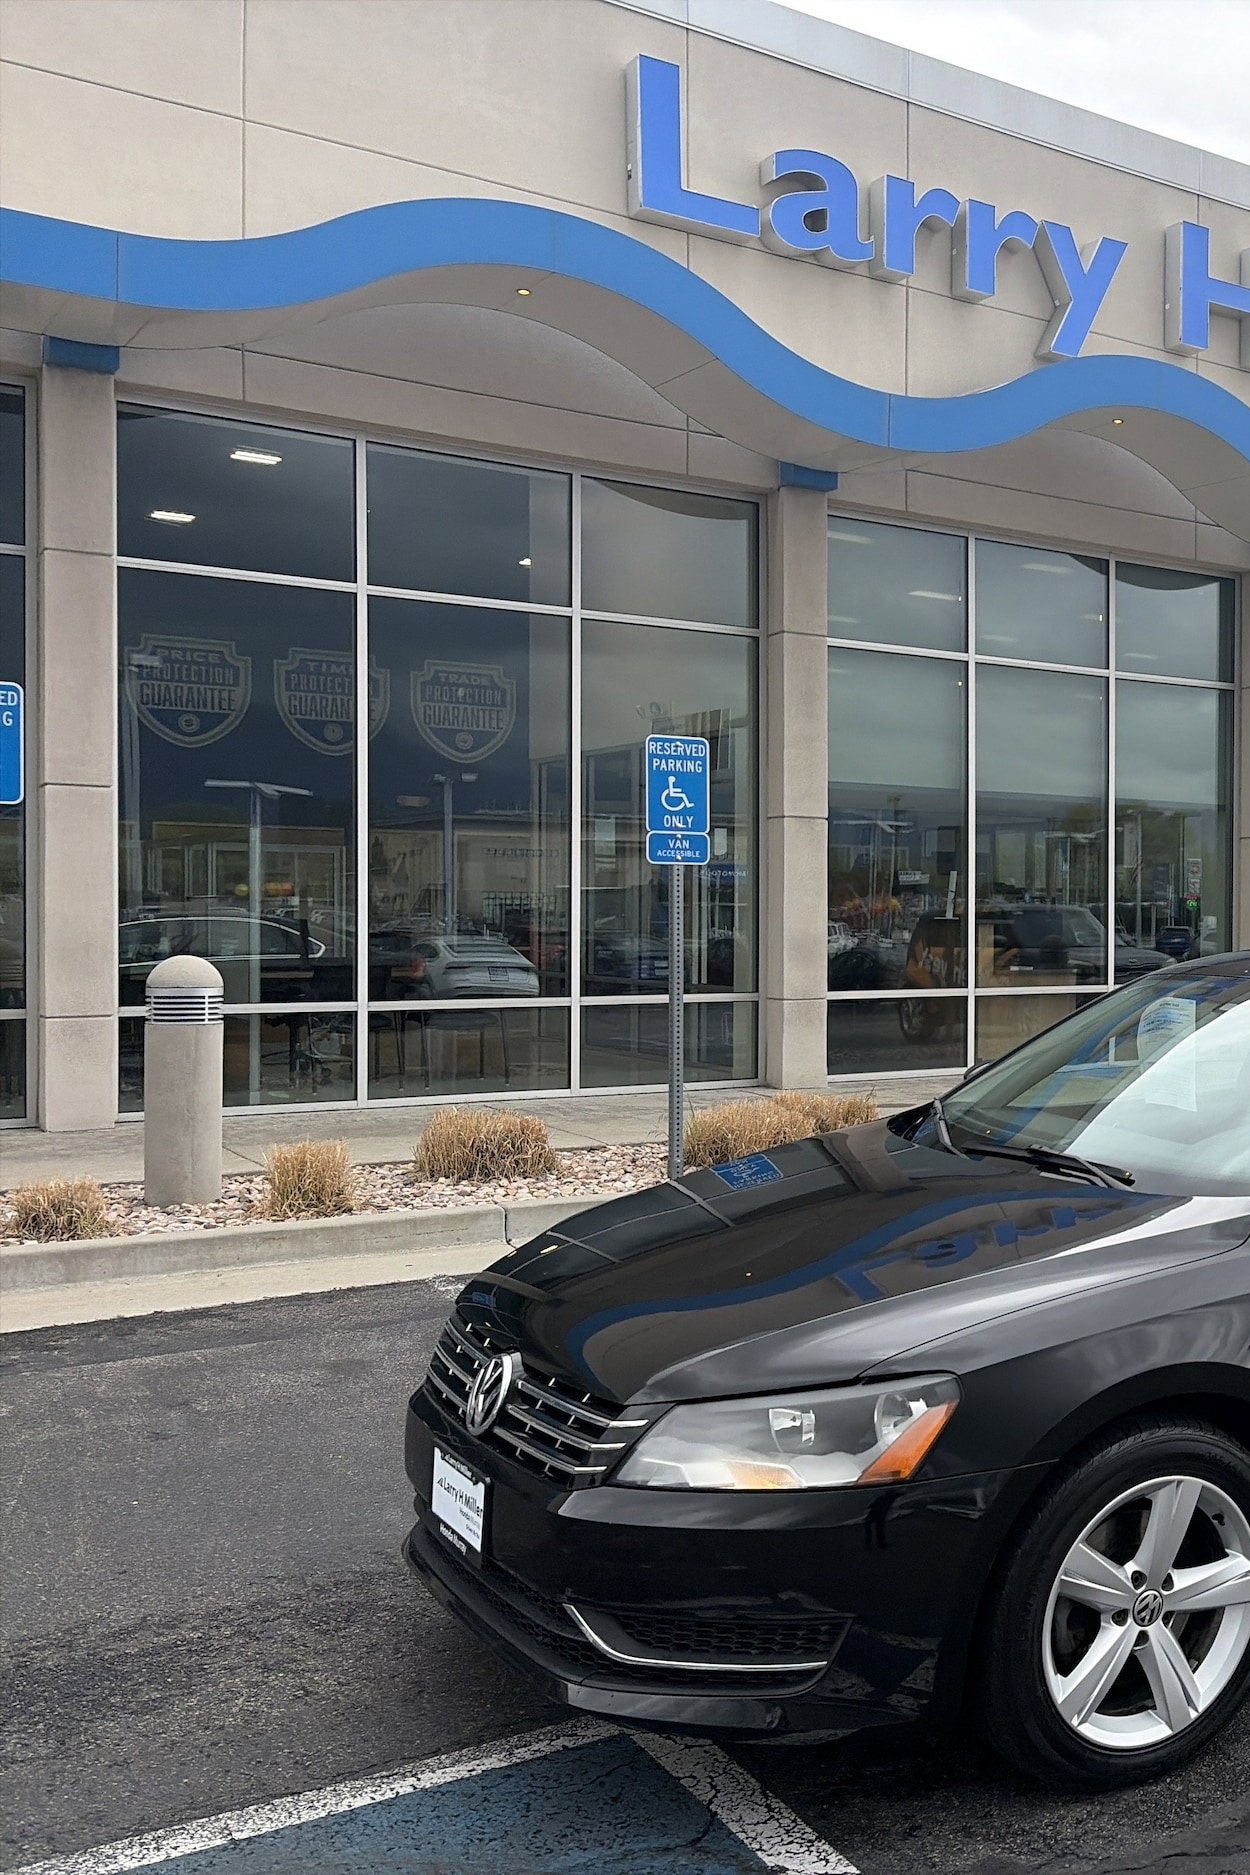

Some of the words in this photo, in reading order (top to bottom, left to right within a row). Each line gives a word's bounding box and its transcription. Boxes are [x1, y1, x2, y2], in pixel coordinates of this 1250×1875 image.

[627, 54, 1128, 358] Larry
[306, 661, 354, 675] TIM
[438, 672, 491, 686] TRADE
[140, 682, 237, 711] GUARANTEE
[423, 703, 503, 730] GUARANTEE
[649, 741, 706, 757] RESERVED
[652, 758, 703, 773] PARKING
[663, 815, 694, 828] ONLY
[668, 839, 690, 850] VAN
[657, 849, 701, 858] ACCESSIBLE
[443, 1477, 458, 1503] Larry
